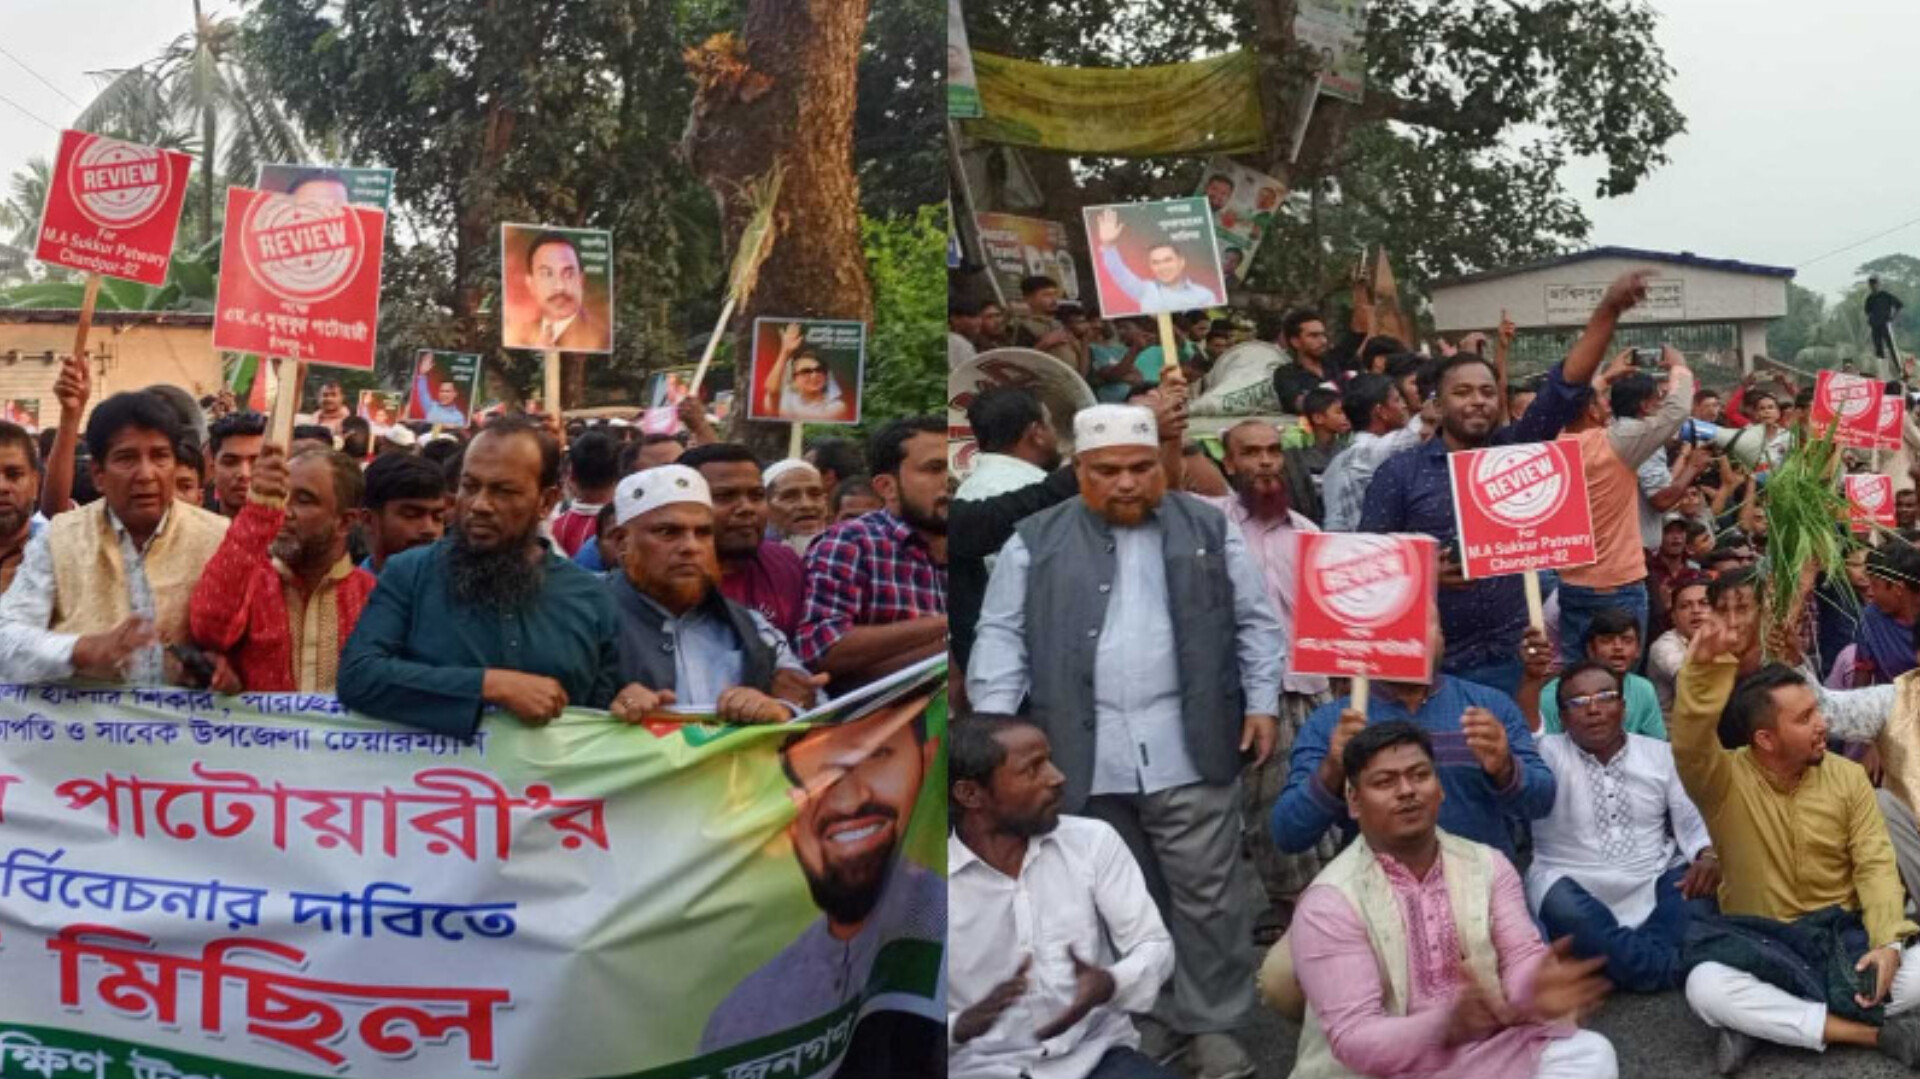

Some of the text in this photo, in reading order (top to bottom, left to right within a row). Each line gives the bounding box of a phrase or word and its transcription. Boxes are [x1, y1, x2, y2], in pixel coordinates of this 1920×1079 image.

[83, 160, 158, 191] REVIEW
[258, 220, 347, 258] REVIEW
[1484, 454, 1554, 501] REVIEW
[65, 722, 86, 741] ও
[94, 721, 180, 744] সাবেক
[189, 718, 309, 749] উপজেলা
[291, 882, 517, 940] দাবিতে
[47, 923, 511, 1067] মিছিল
